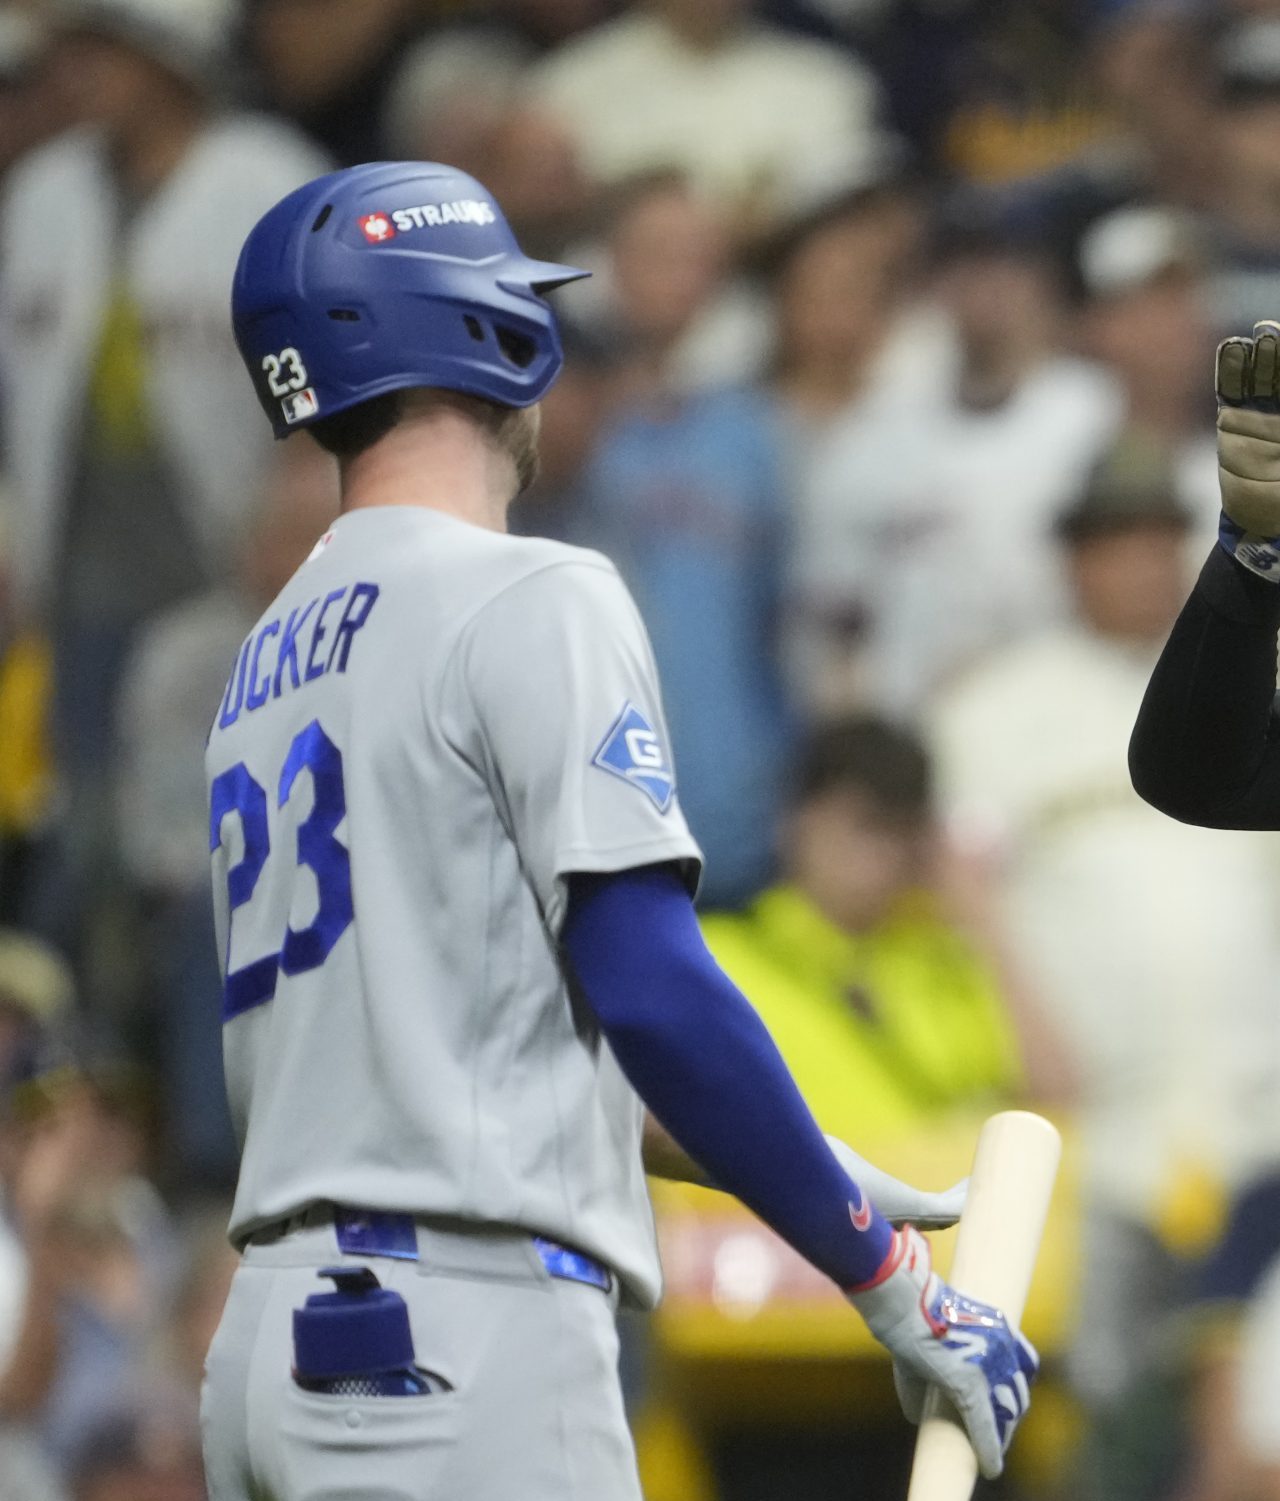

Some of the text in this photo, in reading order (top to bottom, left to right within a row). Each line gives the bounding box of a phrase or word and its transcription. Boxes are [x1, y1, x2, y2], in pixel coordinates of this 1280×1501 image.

[262, 347, 307, 396] 23
[206, 581, 380, 740] UCKER
[624, 727, 663, 768] G
[210, 717, 355, 1025] 23
